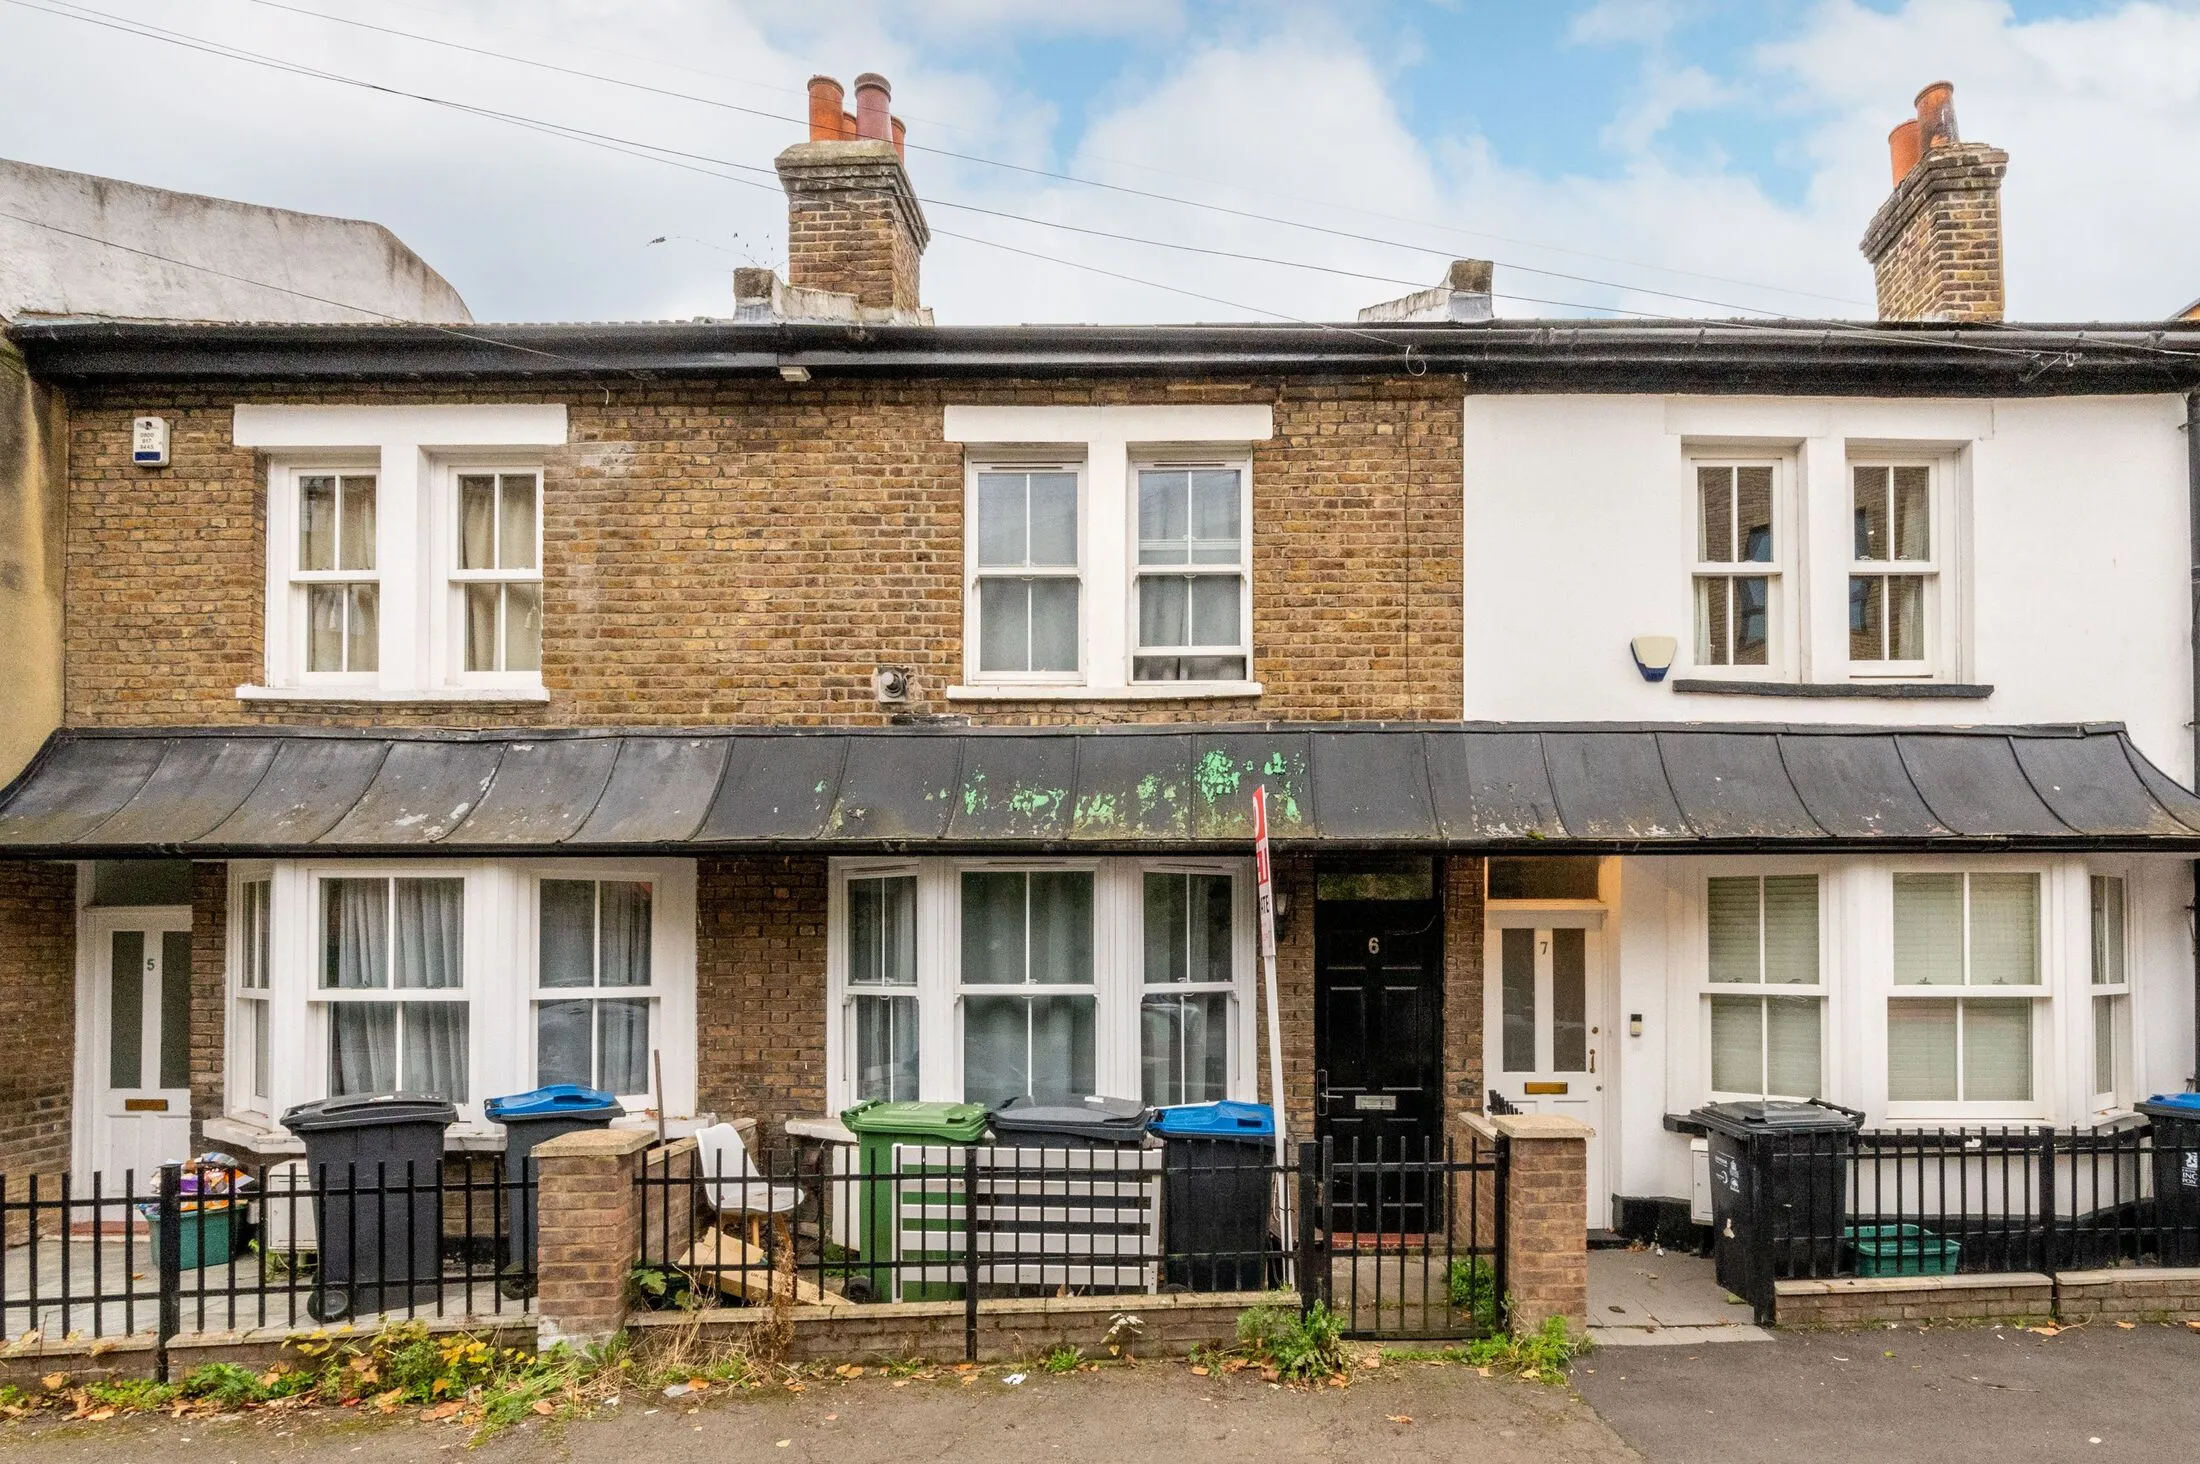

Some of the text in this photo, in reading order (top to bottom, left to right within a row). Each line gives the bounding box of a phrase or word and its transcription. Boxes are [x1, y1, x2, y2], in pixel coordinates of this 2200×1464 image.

[1368, 937, 1380, 955] 6
[1540, 941, 1549, 955] 7
[146, 958, 155, 971] 5
